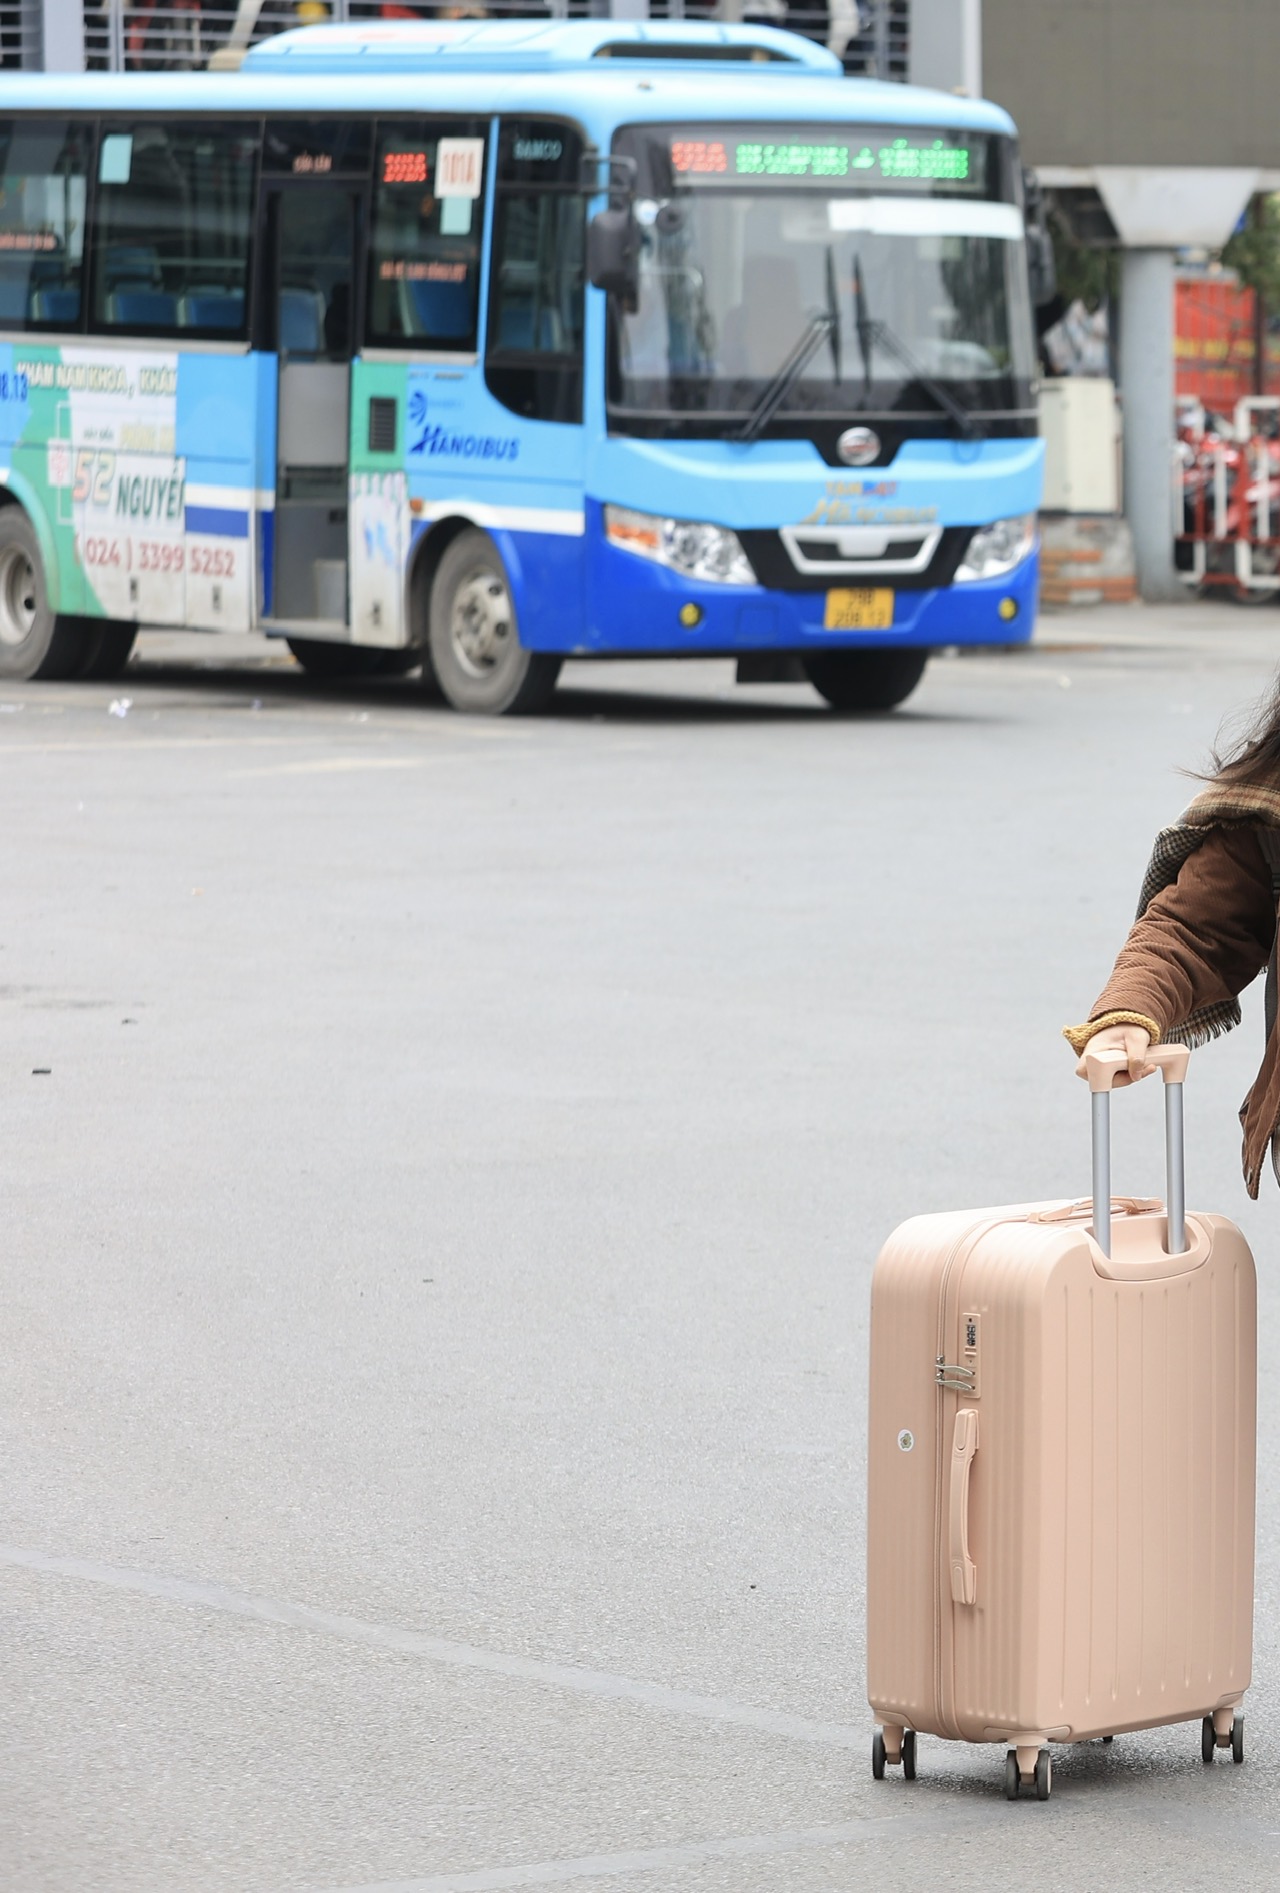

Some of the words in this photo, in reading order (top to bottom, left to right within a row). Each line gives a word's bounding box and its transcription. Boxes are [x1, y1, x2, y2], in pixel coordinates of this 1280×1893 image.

[0, 373, 28, 400] 8.13
[409, 424, 520, 461] HANOIBUS
[72, 448, 116, 504] 52
[139, 542, 185, 573] 3399
[190, 544, 236, 578] 5252
